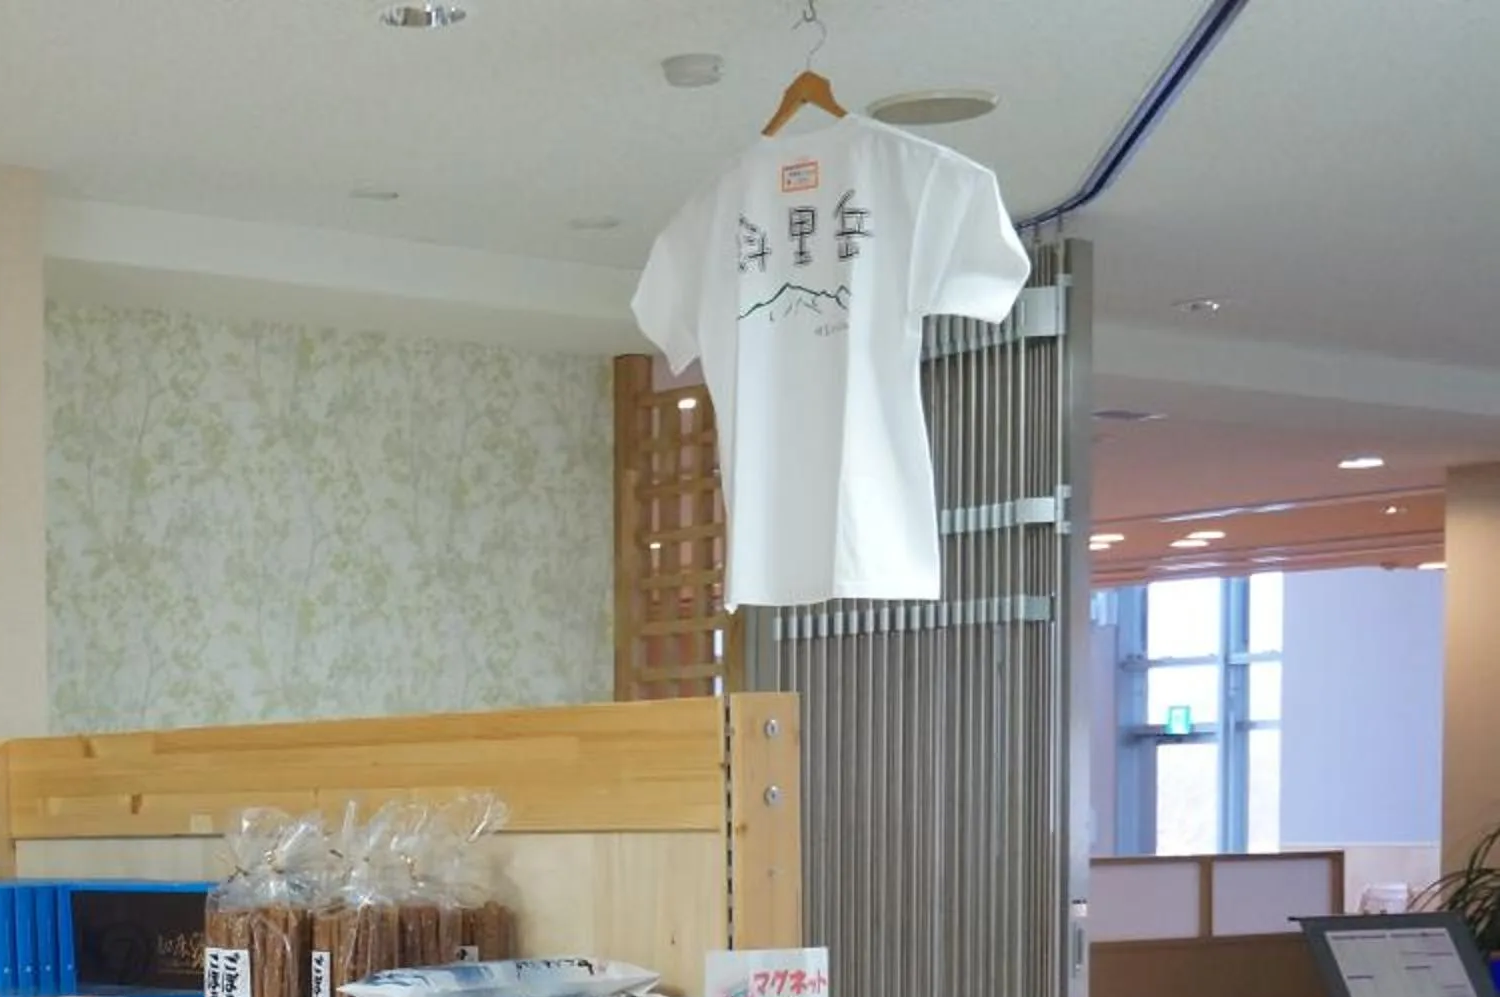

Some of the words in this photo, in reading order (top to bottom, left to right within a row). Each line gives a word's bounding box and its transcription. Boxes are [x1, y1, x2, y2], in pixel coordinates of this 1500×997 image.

[754, 968, 827, 995] マグネット
